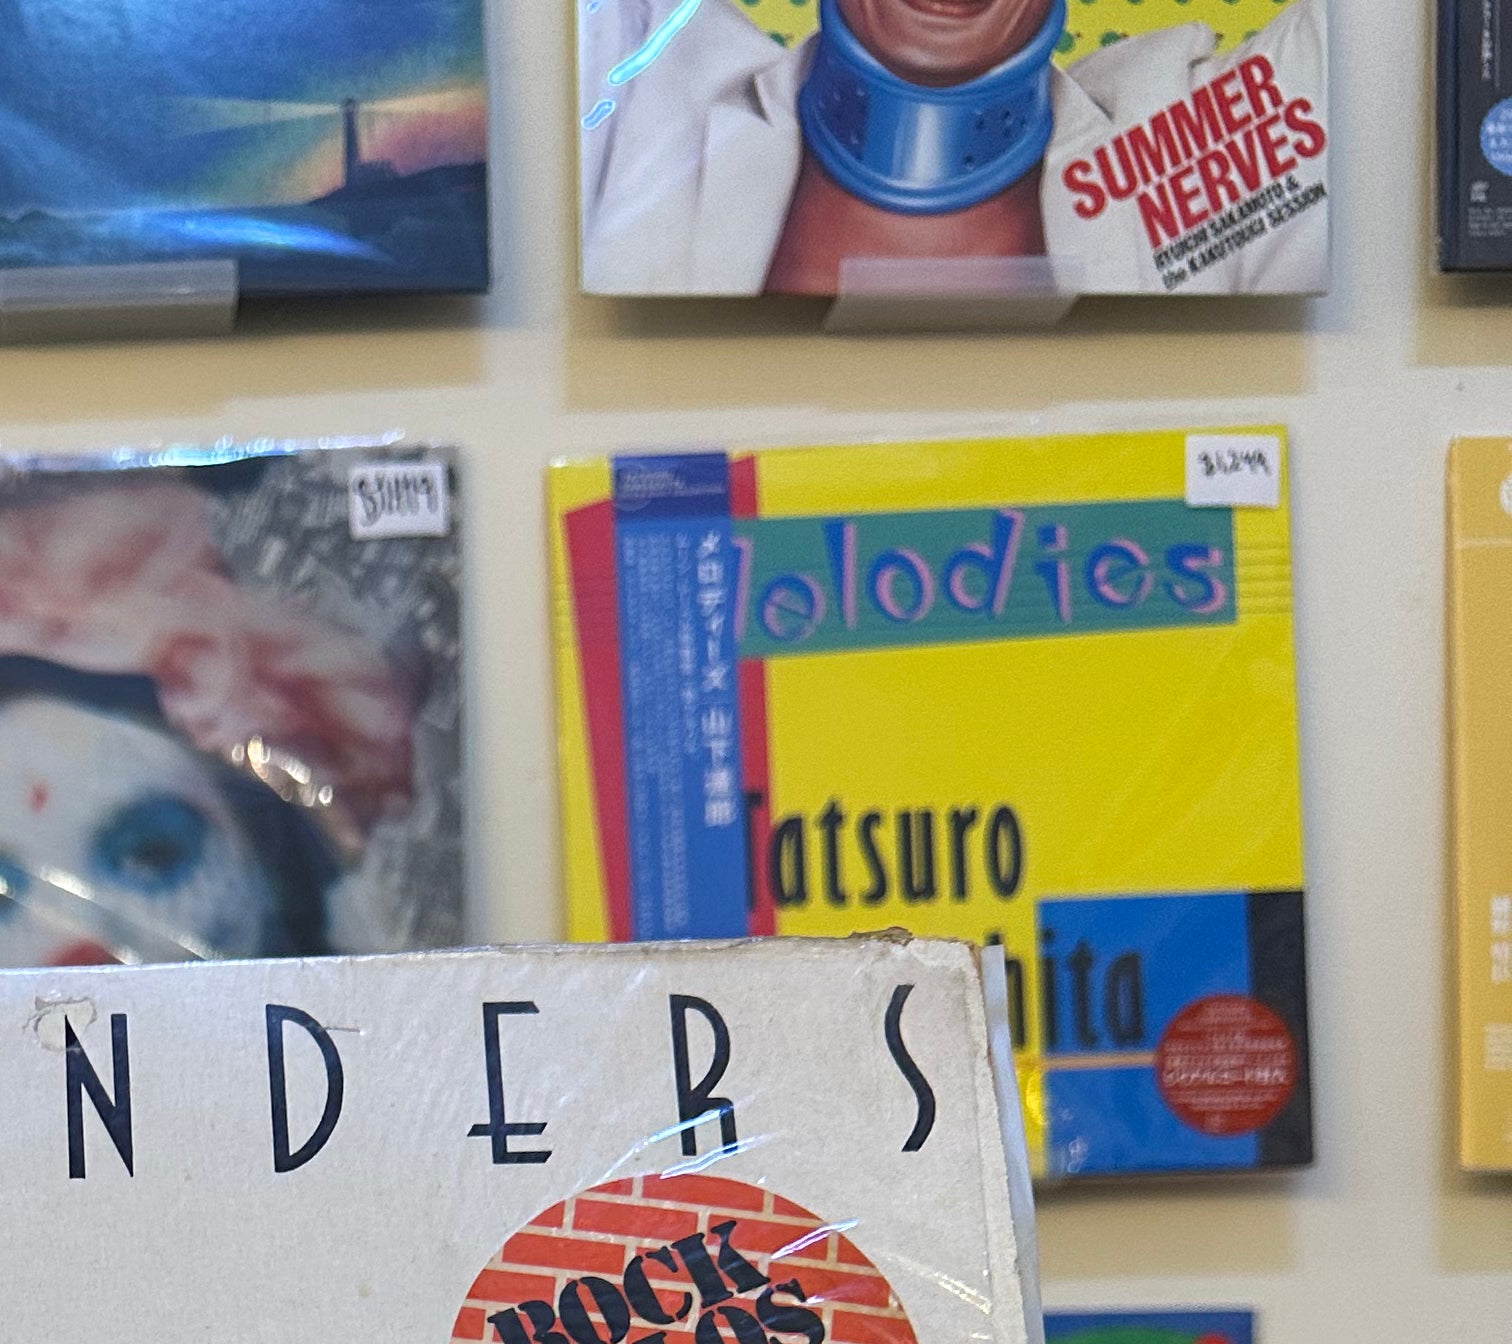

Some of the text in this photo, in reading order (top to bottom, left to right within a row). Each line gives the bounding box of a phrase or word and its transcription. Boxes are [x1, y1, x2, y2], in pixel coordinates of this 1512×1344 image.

[1061, 53, 1284, 220] SUMMER
[1136, 97, 1328, 251] NERVES
[730, 508, 1228, 646] elodies
